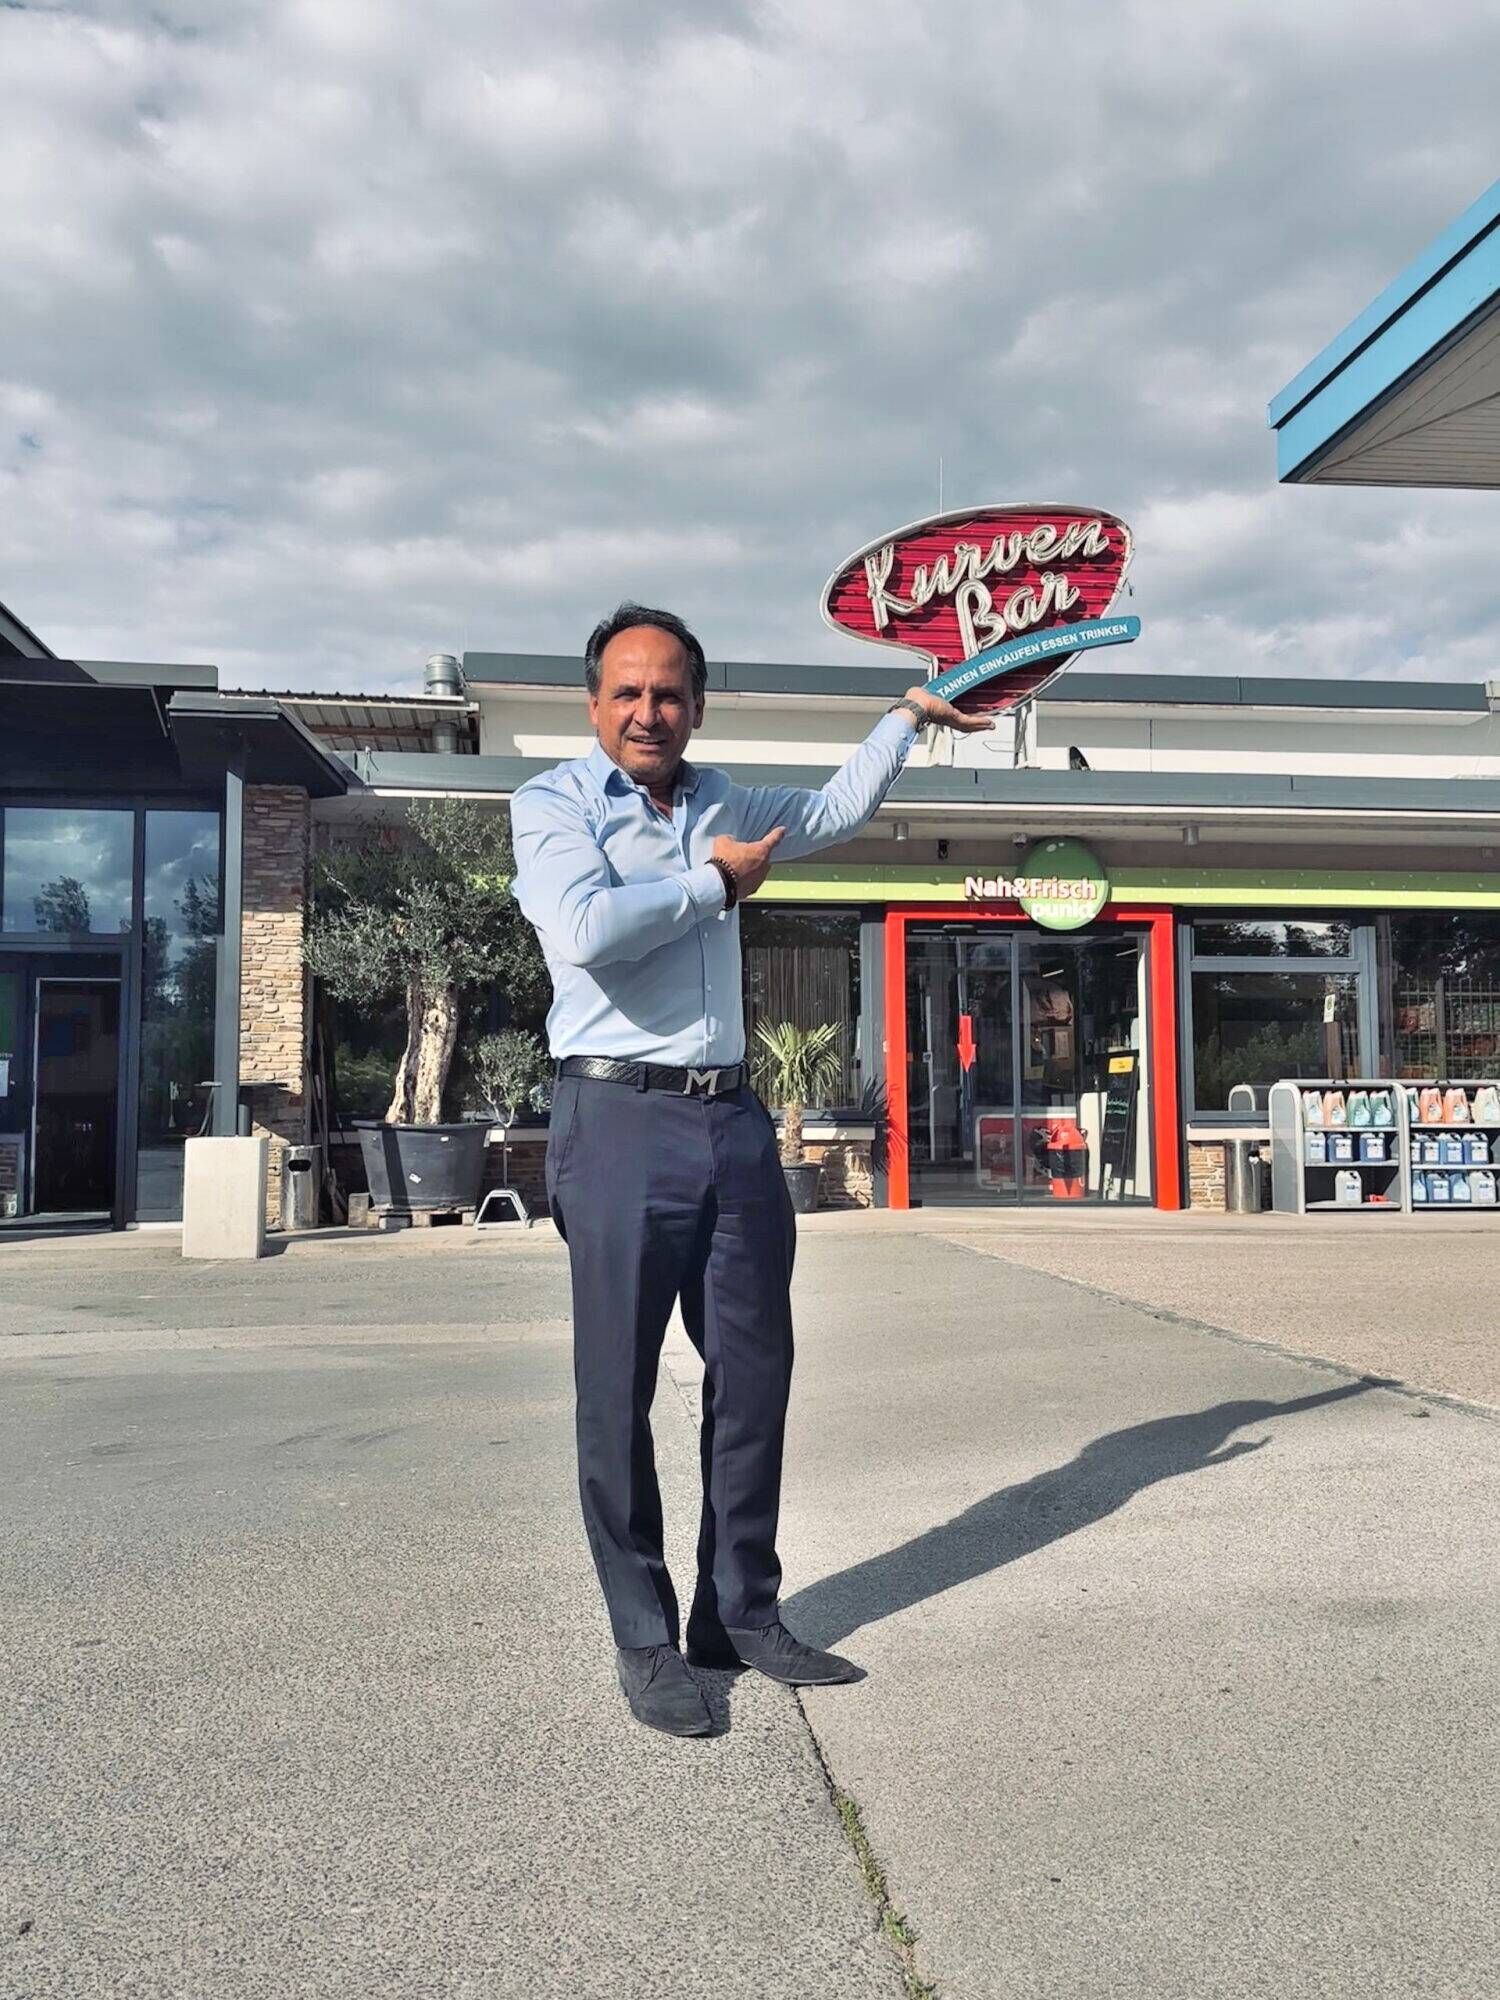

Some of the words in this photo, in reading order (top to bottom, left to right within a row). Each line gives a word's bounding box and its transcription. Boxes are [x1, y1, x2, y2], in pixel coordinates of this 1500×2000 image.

[865, 520, 1109, 631] Kurven
[955, 571, 1080, 661] Bar
[937, 670, 979, 697] TANKEN
[979, 645, 1041, 674] EINKAUFEN
[1042, 634, 1080, 651] ESSEN
[1080, 624, 1128, 641] TRINKEN
[964, 875, 1097, 899] Nah&Frisch
[683, 1069, 720, 1096] M
